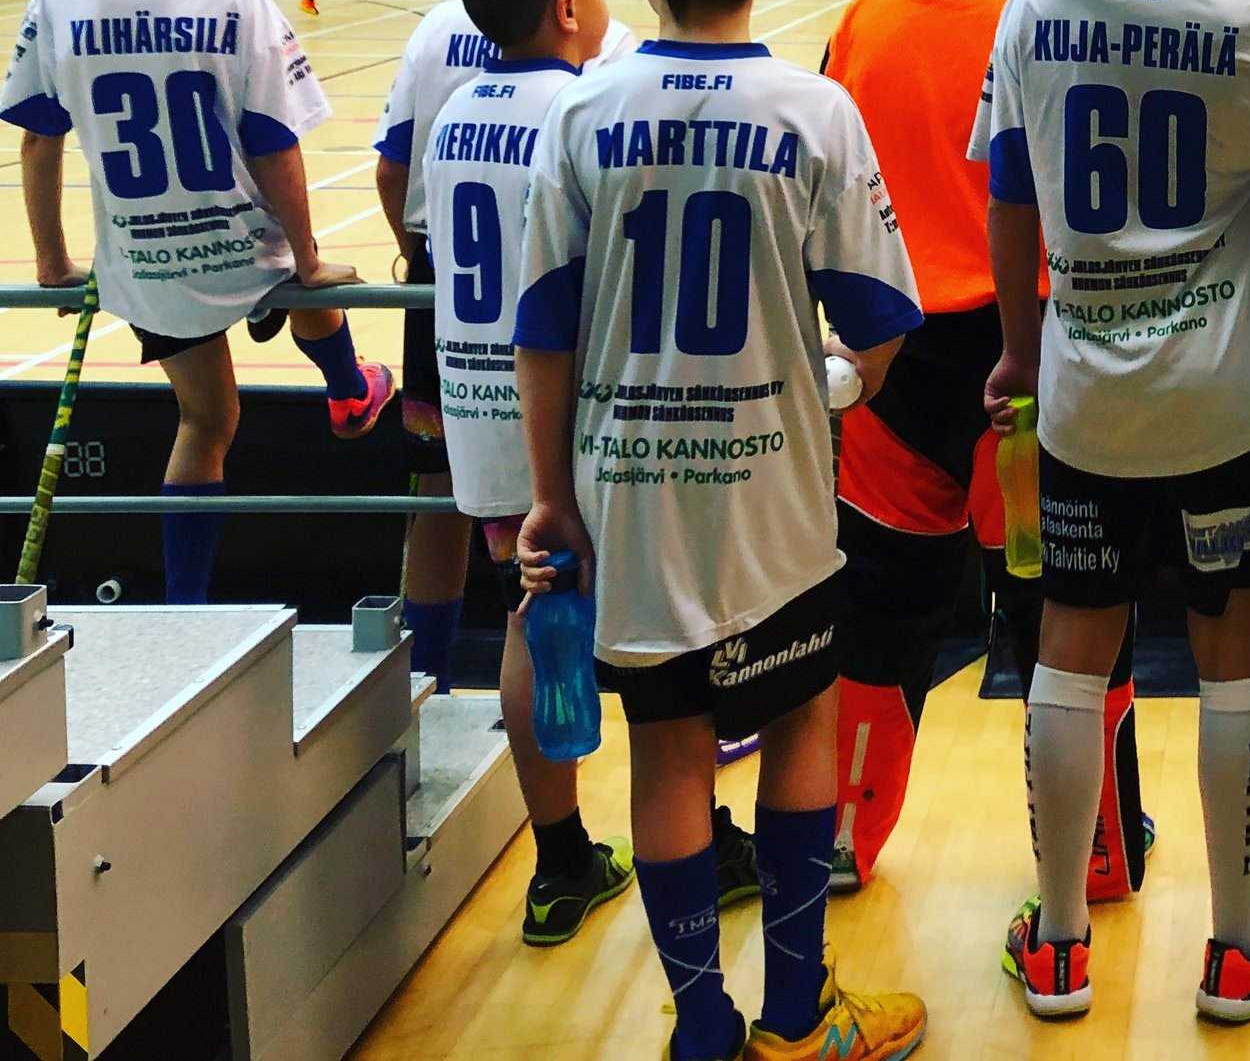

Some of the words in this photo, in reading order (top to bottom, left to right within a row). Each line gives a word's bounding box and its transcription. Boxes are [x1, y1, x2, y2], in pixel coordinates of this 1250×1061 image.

[71, 11, 240, 56] YLIHÄRSILÄ
[1034, 20, 1240, 77] KUJA-PERÄLÄ
[662, 74, 733, 90] FIBE.FI
[91, 70, 236, 199] 30
[596, 120, 799, 179] MARTTILA
[1064, 84, 1207, 234] 60
[121, 247, 171, 264] -TALO
[453, 181, 502, 324] 9
[623, 189, 751, 356] 10
[1121, 280, 1236, 321] KANNOSTO
[1148, 316, 1207, 338] Parkano
[657, 431, 784, 459] KANNOSTO
[595, 467, 665, 486] Jalasjärvi
[683, 468, 751, 484] Parkano
[1049, 542, 1097, 571] Talvitie
[1101, 546, 1120, 575] Ky
[709, 624, 835, 686] Kannonlahti
